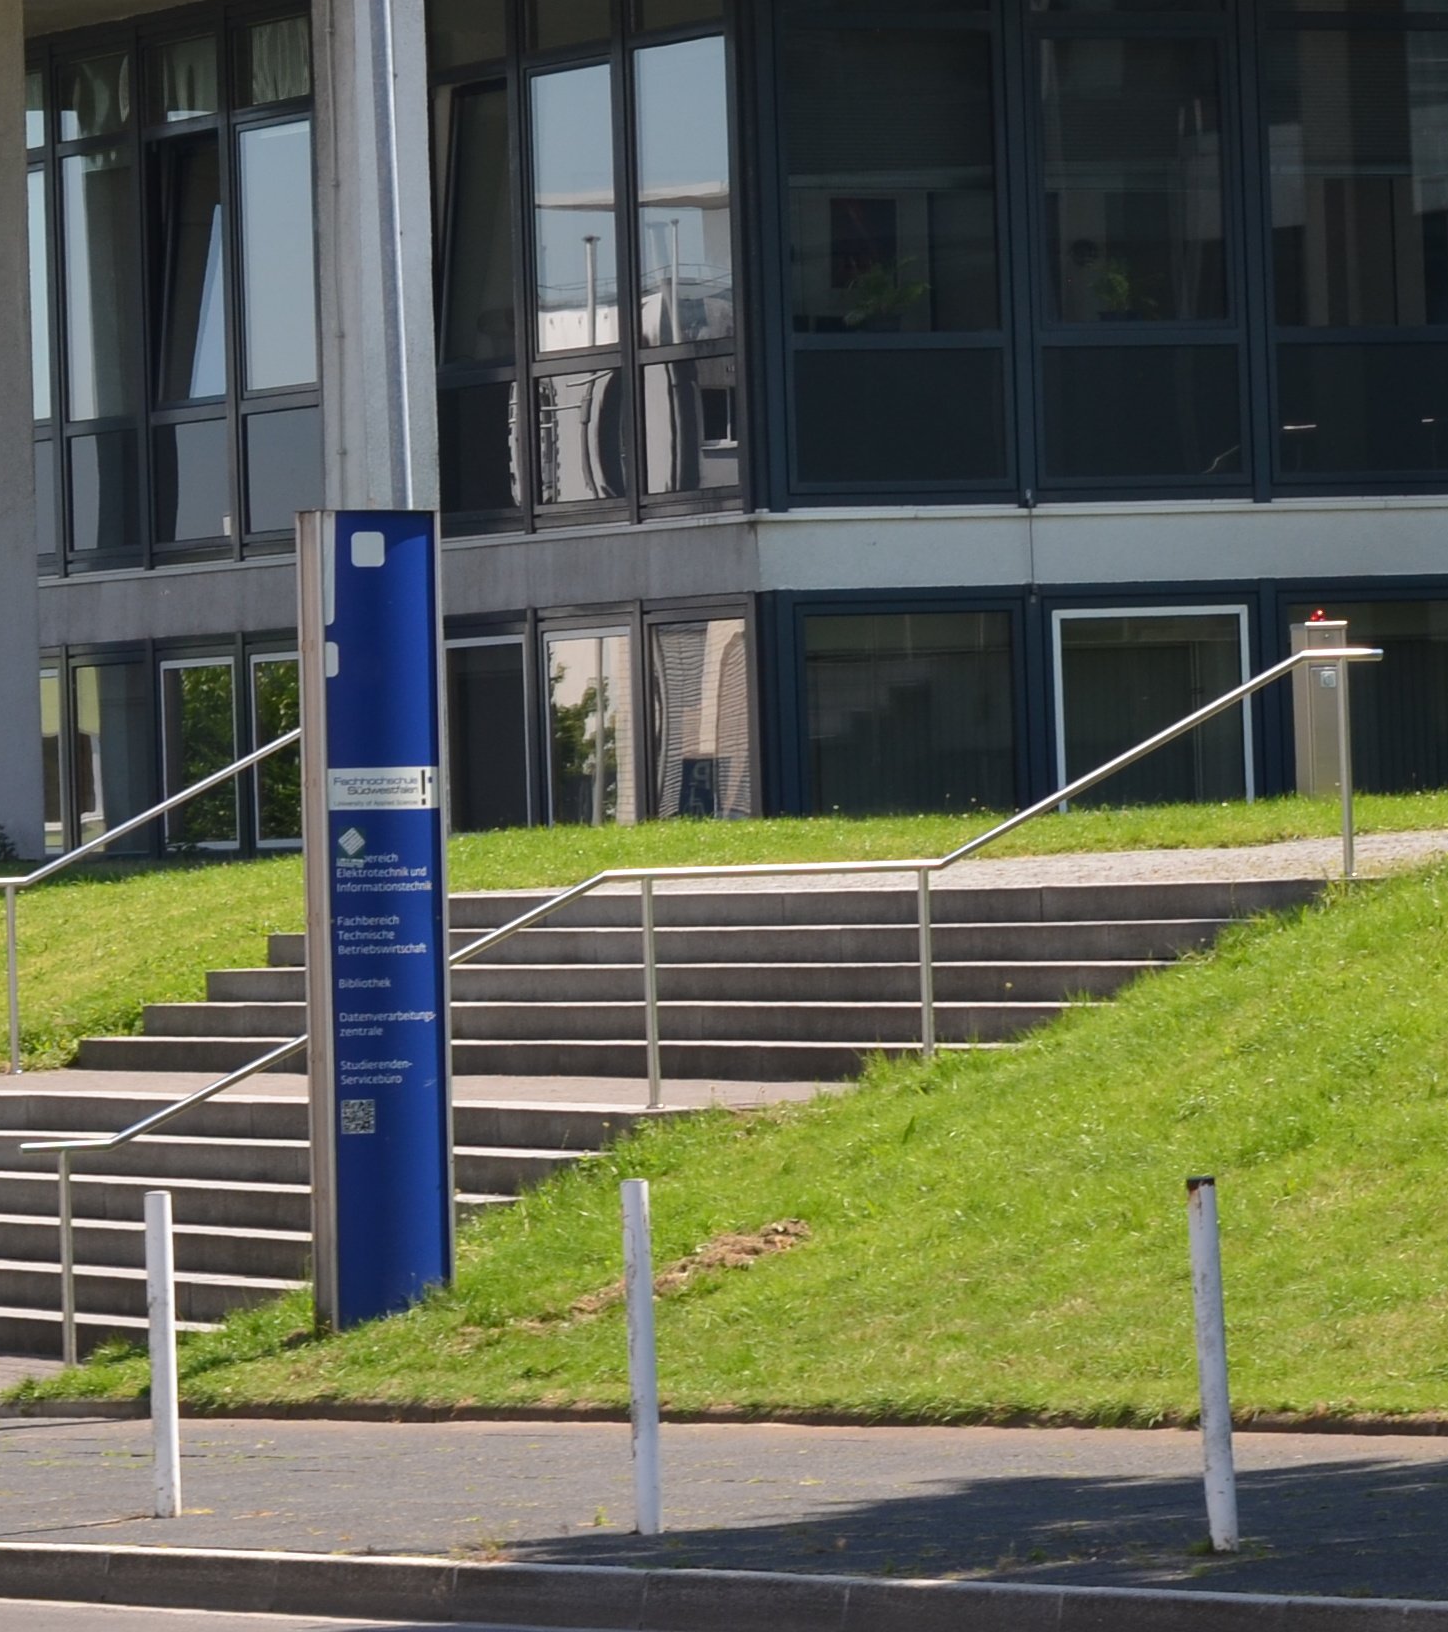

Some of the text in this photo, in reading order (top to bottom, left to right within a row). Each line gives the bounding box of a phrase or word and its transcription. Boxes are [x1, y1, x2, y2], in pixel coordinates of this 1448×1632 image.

[334, 776, 418, 786] Fachhochschule
[347, 786, 418, 796] Südwestfalen
[336, 866, 427, 878] Elektrotechnik und
[337, 915, 400, 926] Fachbereich
[337, 930, 395, 940] Technische
[337, 942, 427, 955] Betriebswirtschaft
[338, 977, 391, 989] Bibliothek
[339, 1026, 383, 1037] zentrale
[340, 1073, 403, 1085] Servicebüro
